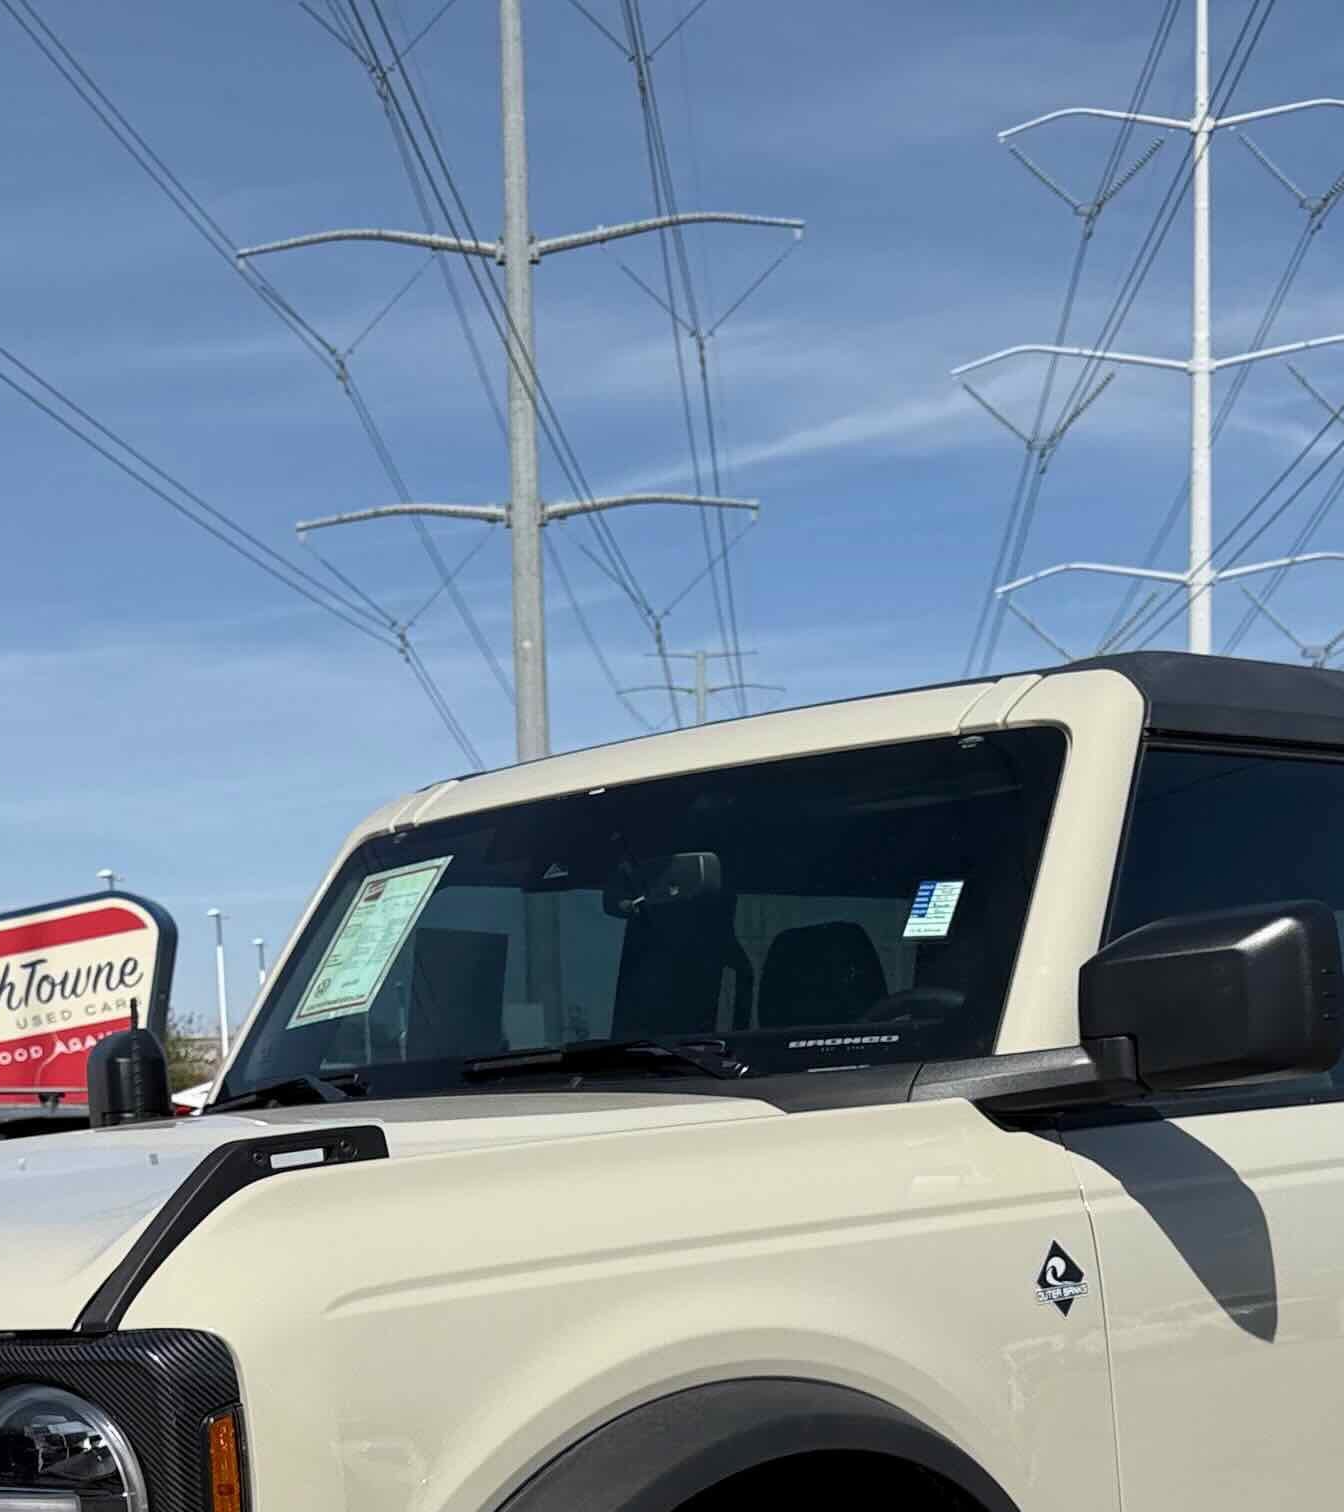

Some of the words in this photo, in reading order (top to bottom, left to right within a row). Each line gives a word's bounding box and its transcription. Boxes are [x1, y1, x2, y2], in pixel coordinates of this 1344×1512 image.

[15, 1009, 73, 1030] USED
[54, 1030, 113, 1056] AGA
[788, 1035, 899, 1049] BRONCO
